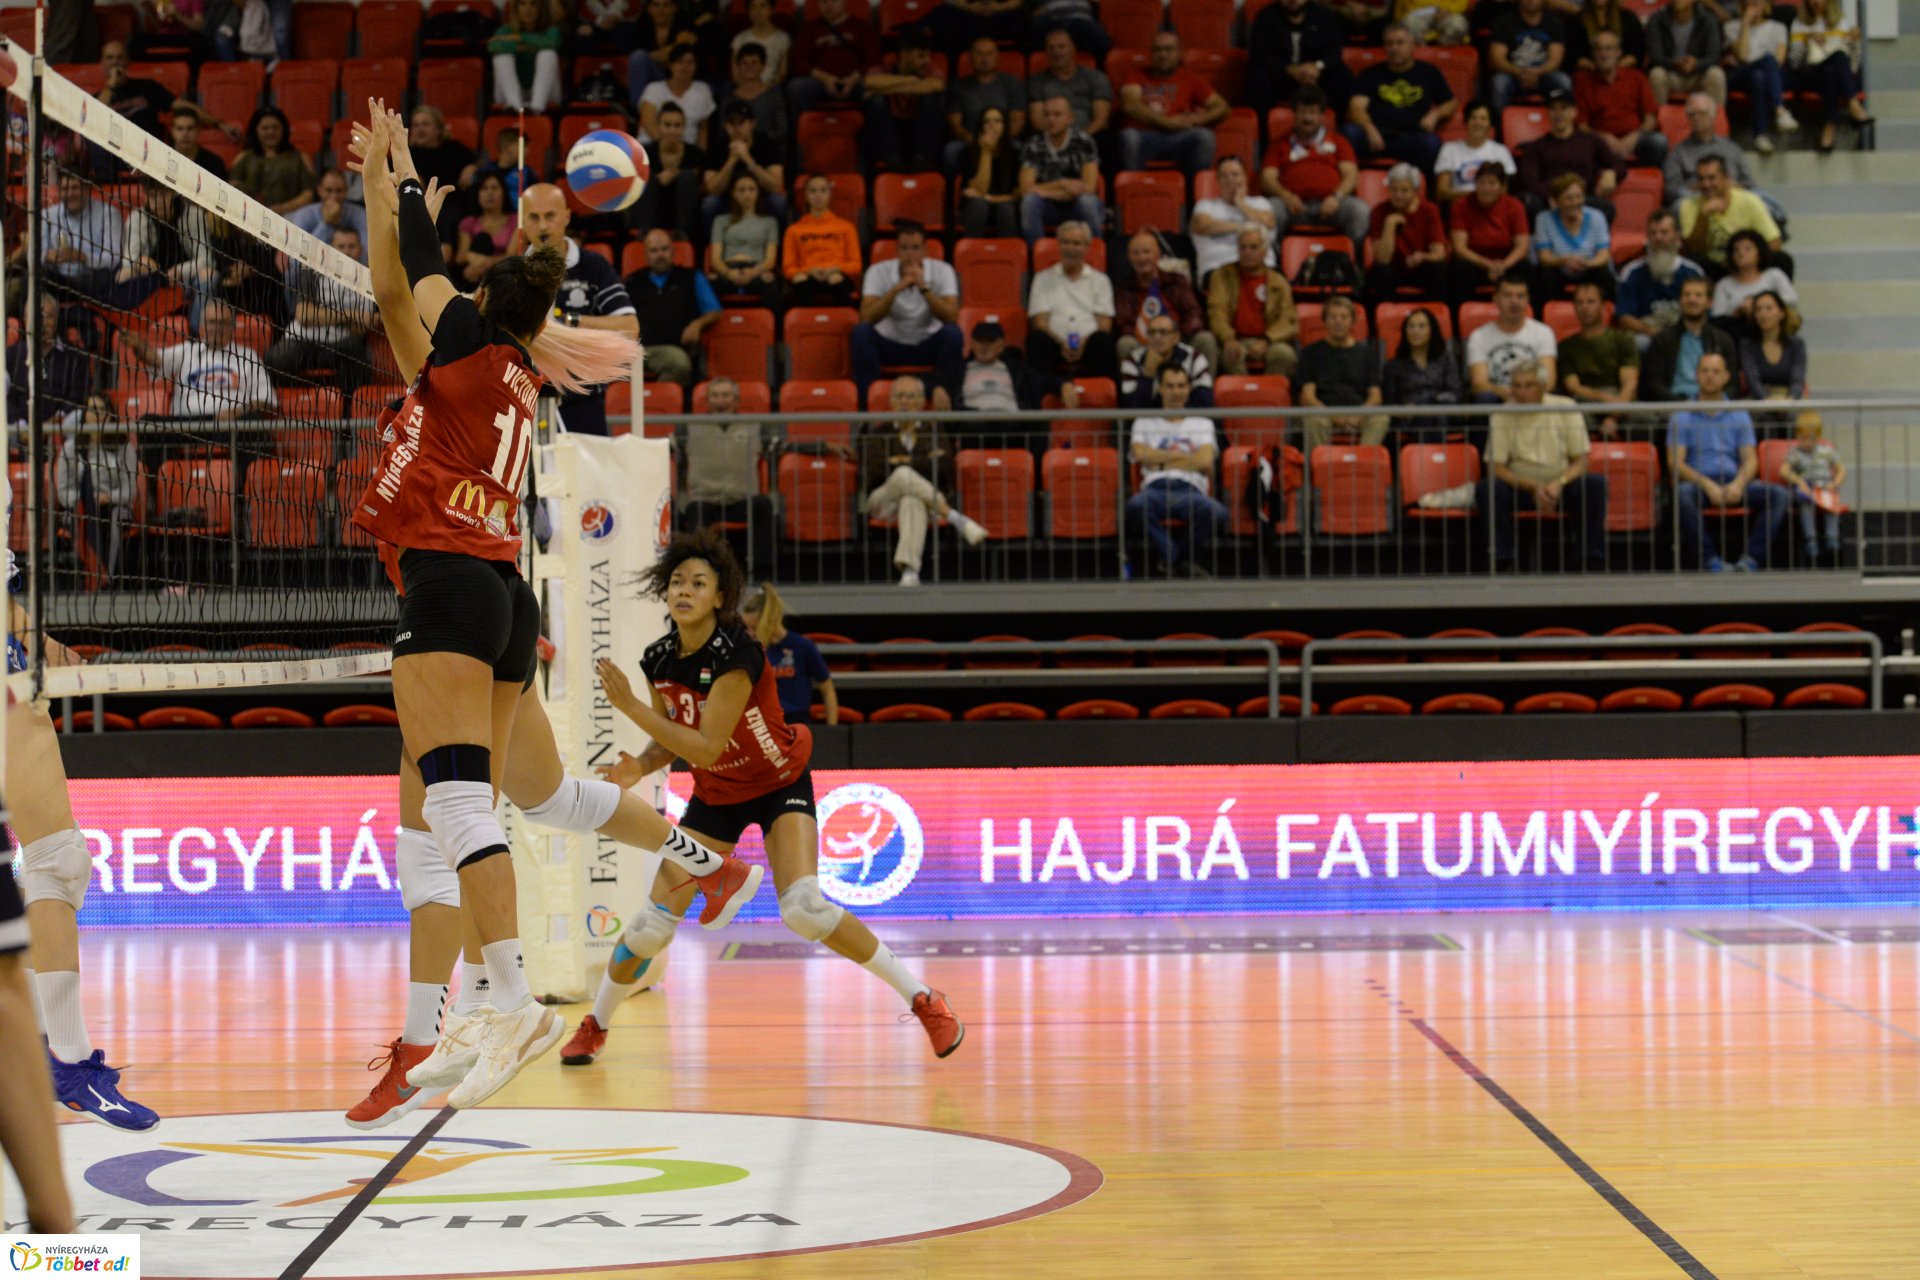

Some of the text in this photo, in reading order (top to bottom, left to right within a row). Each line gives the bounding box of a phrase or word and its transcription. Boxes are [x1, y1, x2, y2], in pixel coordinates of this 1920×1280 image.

[503, 361, 539, 416] VICTORI
[481, 404, 532, 499] 10
[680, 693, 695, 725] 3
[79, 808, 402, 893] REGYHÁ
[588, 831, 618, 887] FAT
[979, 798, 1250, 883] HAJRÁ
